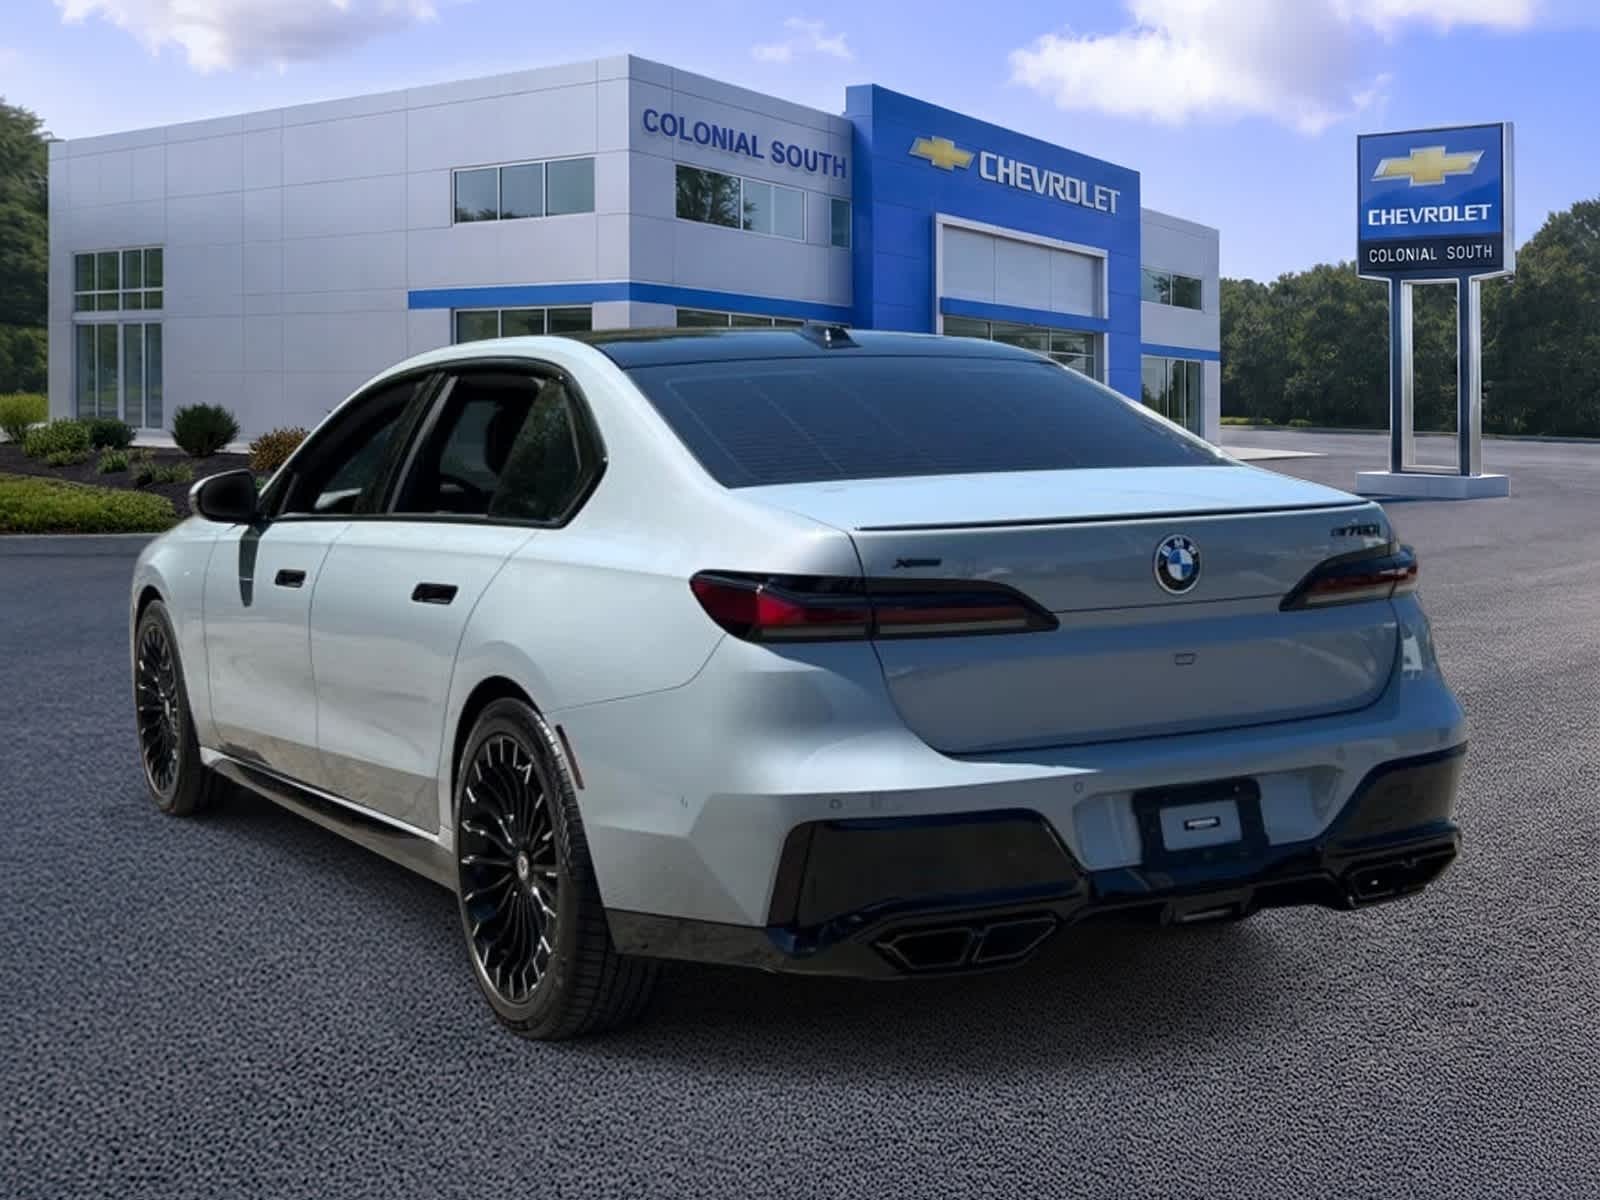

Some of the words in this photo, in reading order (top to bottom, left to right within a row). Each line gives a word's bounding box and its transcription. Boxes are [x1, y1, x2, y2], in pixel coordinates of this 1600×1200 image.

[643, 108, 765, 160] COLONIAL
[771, 140, 847, 179] SOUTH
[979, 150, 1120, 214] CHEVROLET
[1368, 203, 1492, 226] CHEVROLET
[1369, 247, 1437, 263] COLONIAL
[1447, 244, 1493, 260] SOUTH
